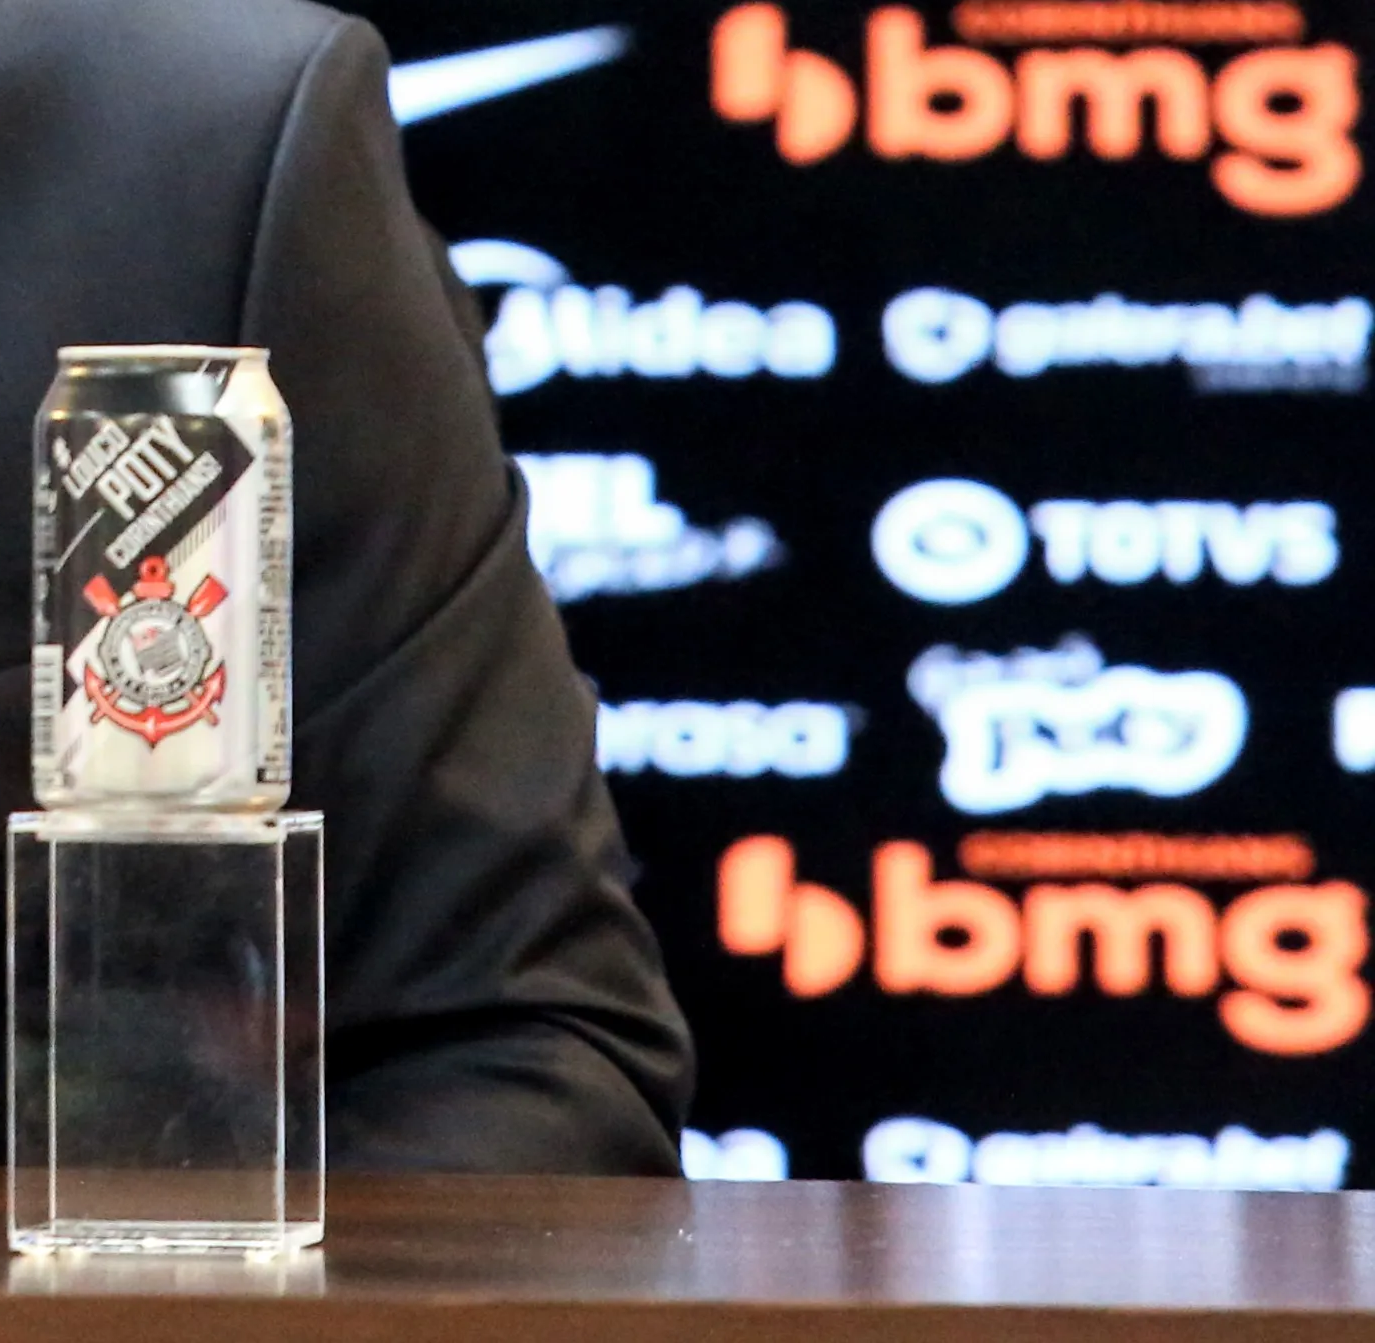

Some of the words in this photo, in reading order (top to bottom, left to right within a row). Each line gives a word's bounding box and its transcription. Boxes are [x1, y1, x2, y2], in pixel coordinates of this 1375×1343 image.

[867, 1, 1361, 215] bmg
[489, 282, 837, 394] Midea
[62, 419, 130, 500] LOUCO
[97, 414, 195, 521] POTY
[1034, 499, 1340, 586] TOTVS
[871, 839, 1370, 1055] bmg
